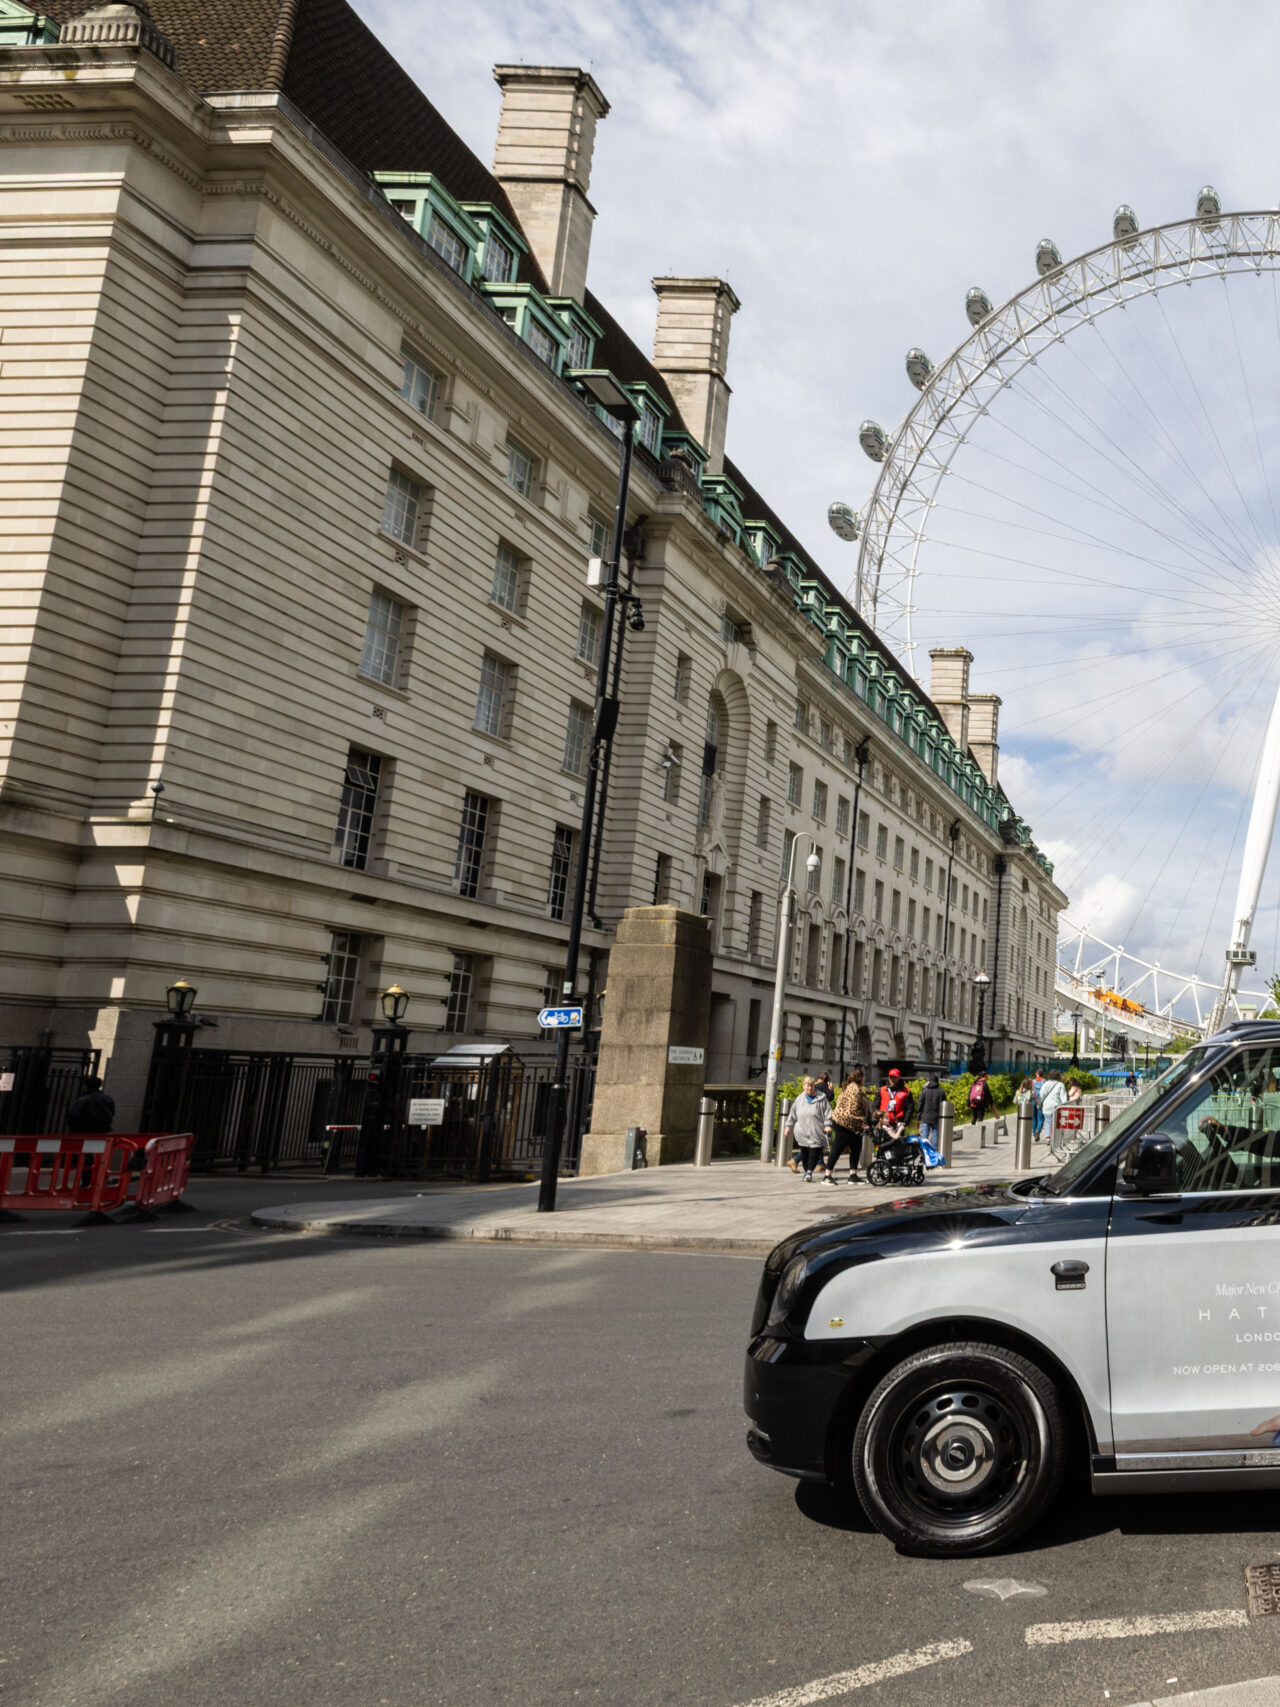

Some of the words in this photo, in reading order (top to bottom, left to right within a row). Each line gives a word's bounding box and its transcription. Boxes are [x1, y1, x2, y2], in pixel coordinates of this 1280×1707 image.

[1215, 1282, 1245, 1298] Major
[1246, 1282, 1268, 1295] New
[1173, 1365, 1202, 1376] NOW
[1203, 1363, 1236, 1375] OPEN
[1239, 1362, 1254, 1373] AT
